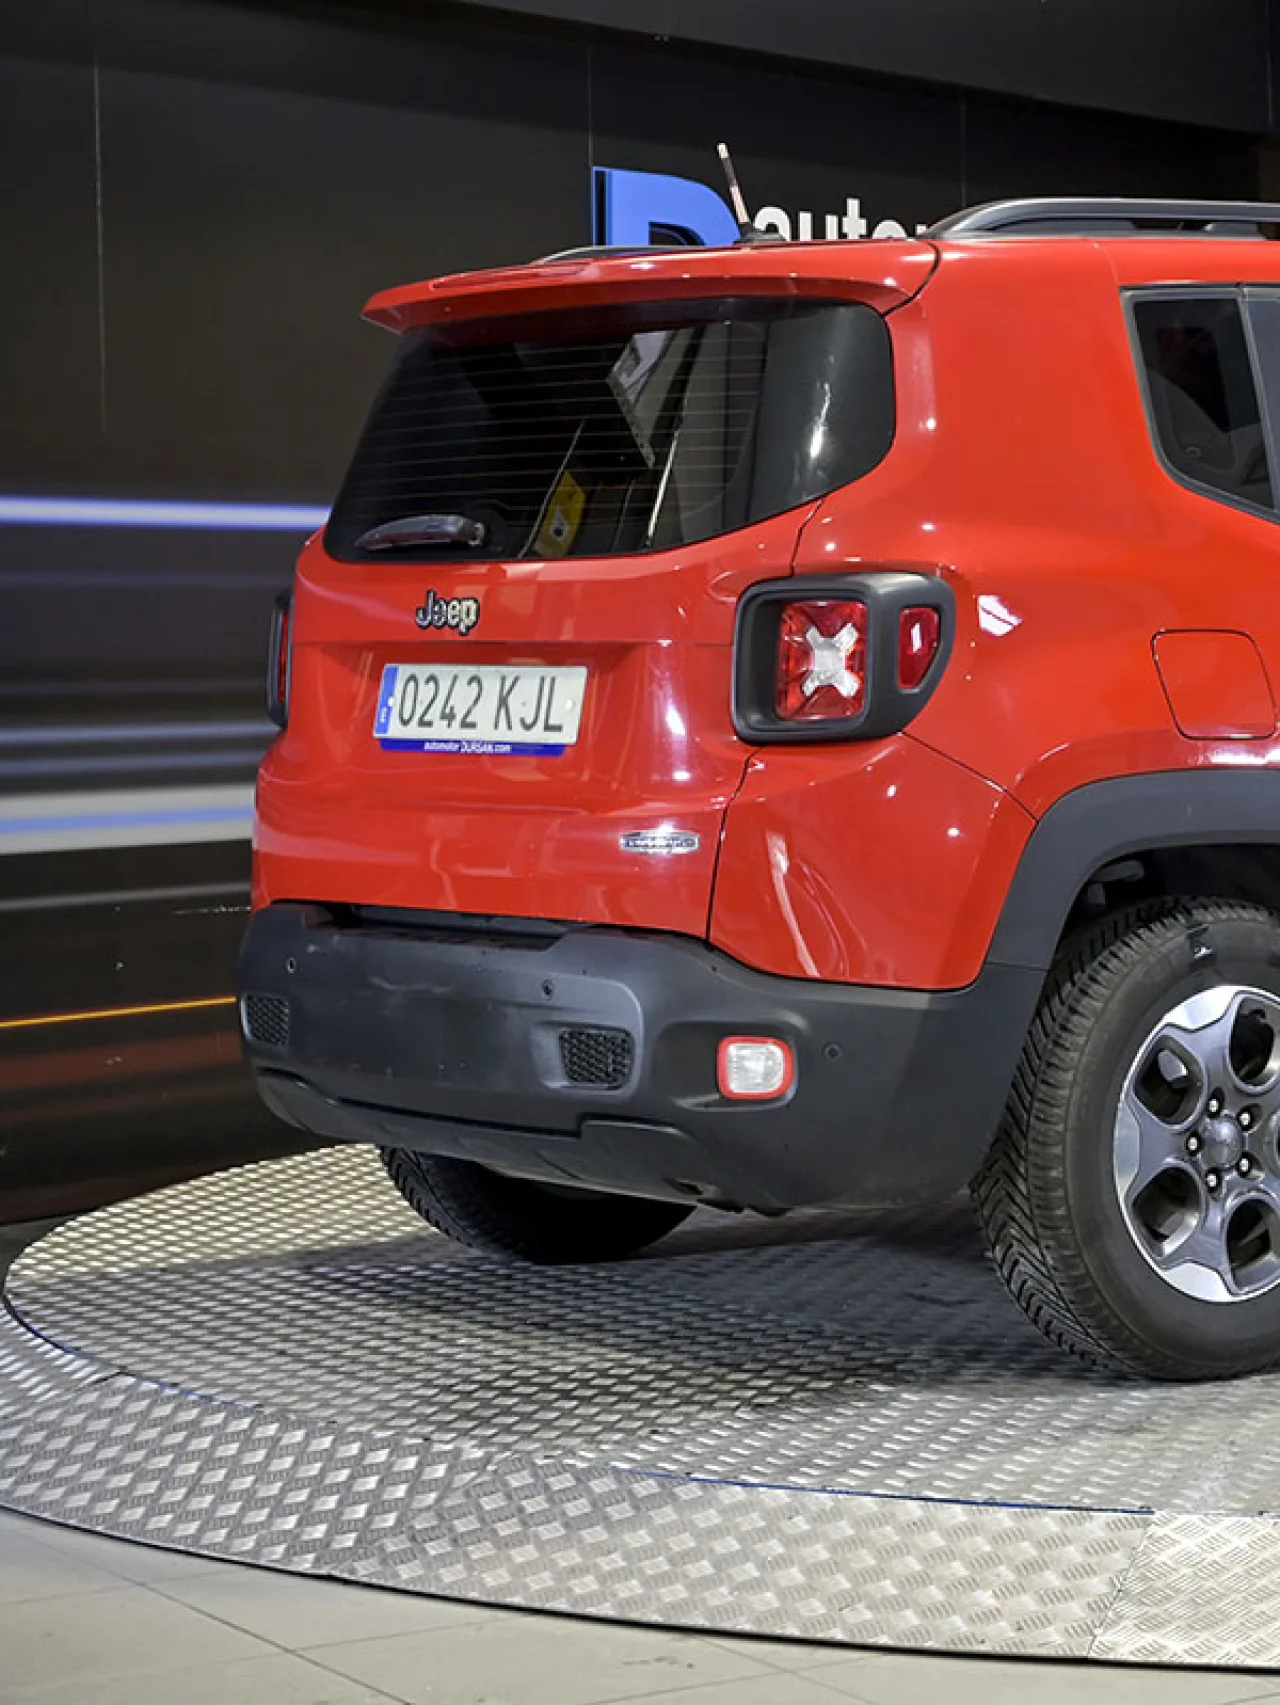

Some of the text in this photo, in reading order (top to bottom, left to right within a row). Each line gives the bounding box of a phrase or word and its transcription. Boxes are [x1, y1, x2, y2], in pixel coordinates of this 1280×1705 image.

[416, 589, 479, 636] Jeep
[400, 673, 563, 732] 0242 KJL
